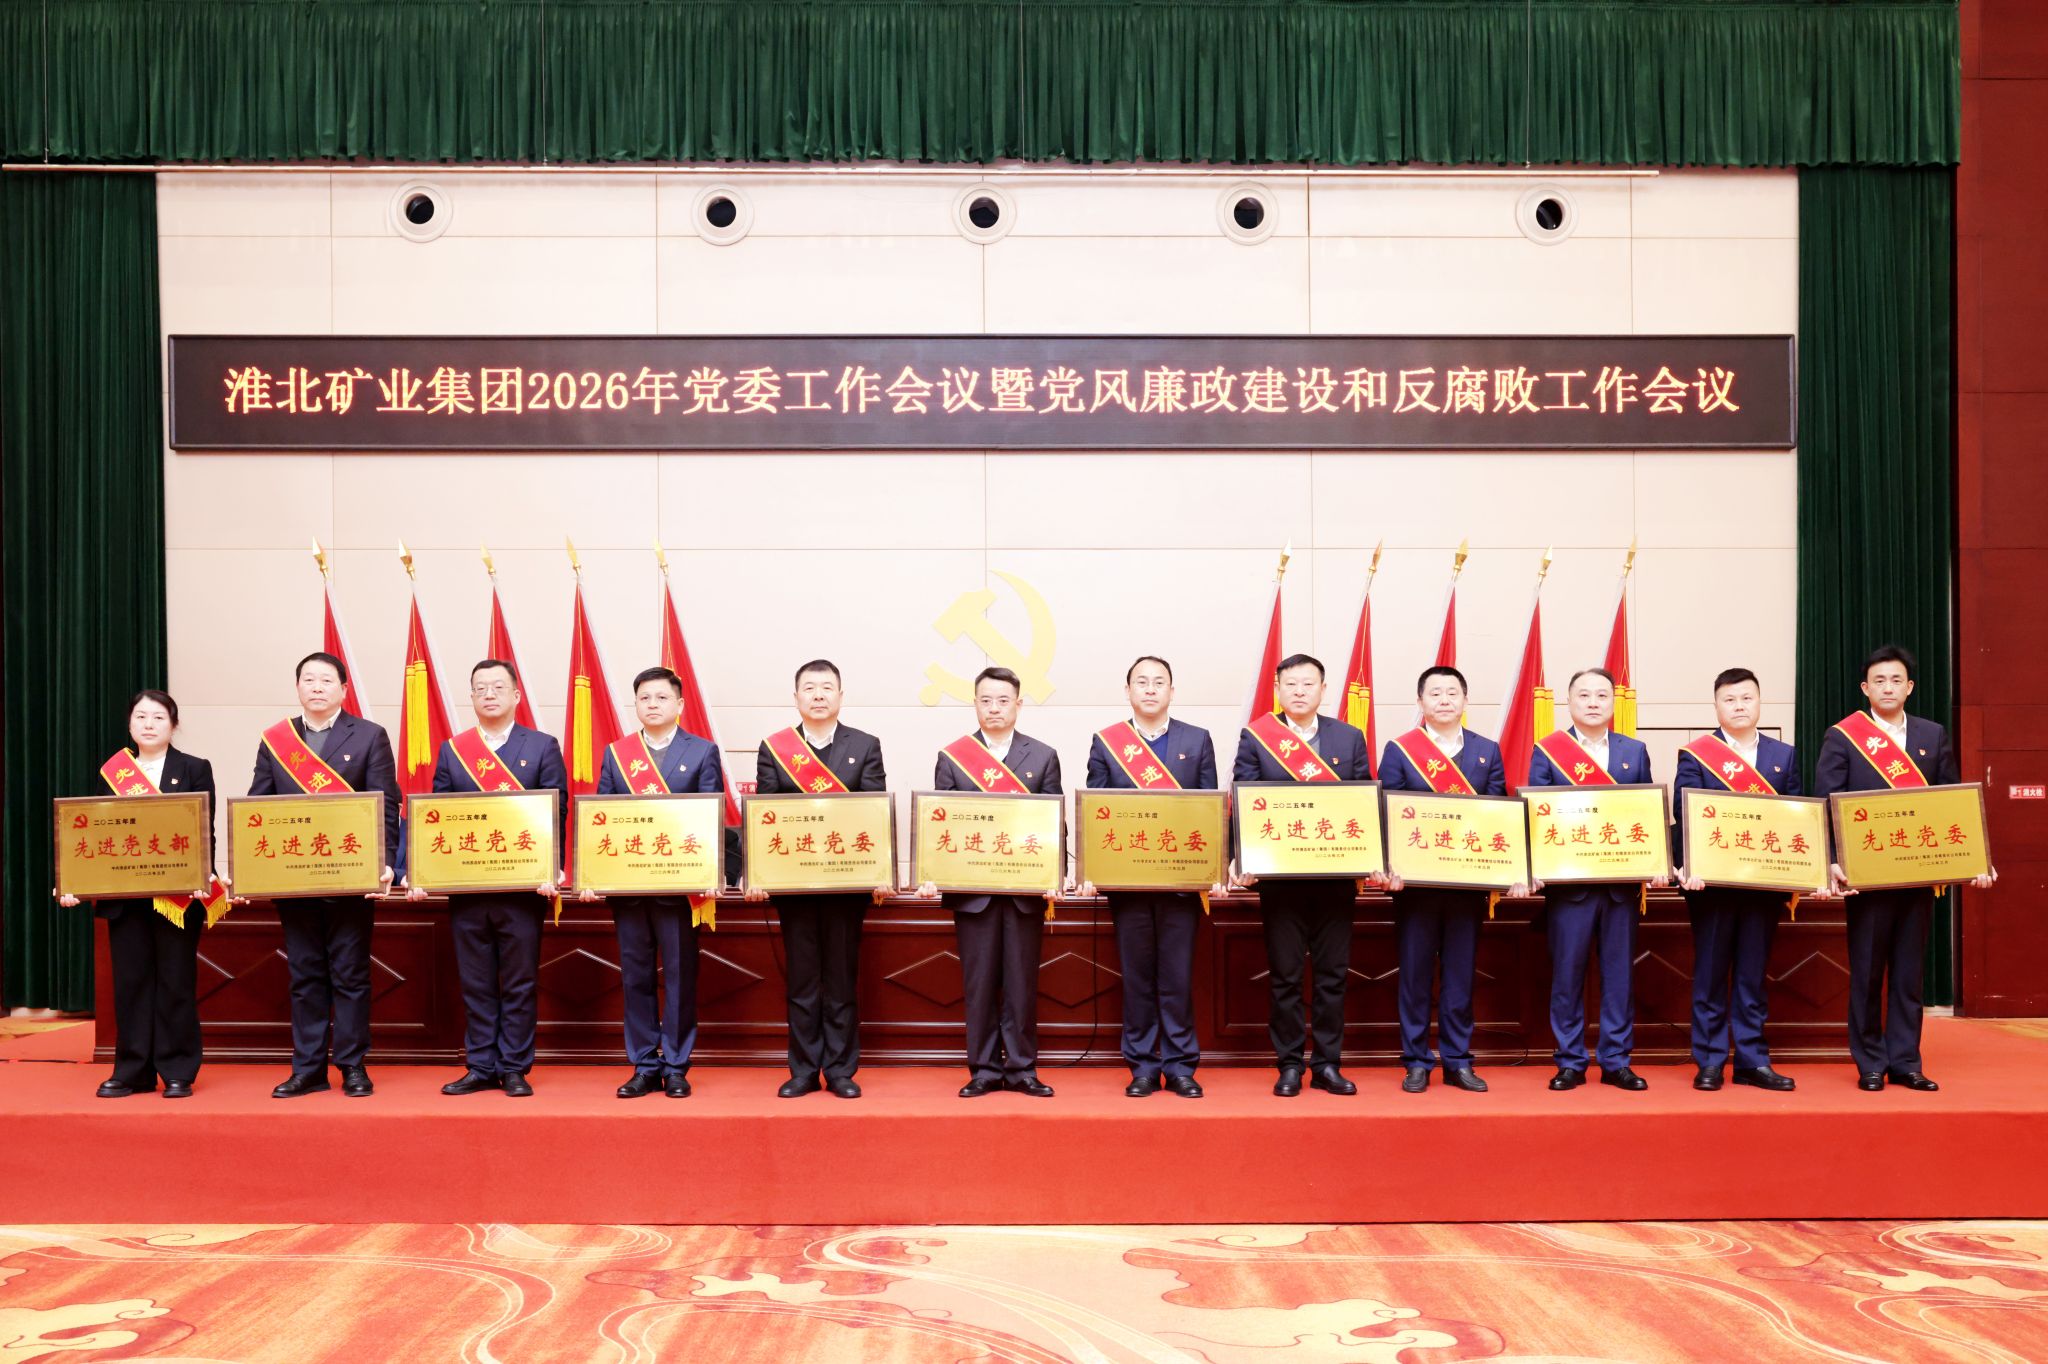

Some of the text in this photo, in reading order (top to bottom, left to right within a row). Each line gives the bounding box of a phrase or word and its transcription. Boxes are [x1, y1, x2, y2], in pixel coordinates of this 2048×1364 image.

[223, 366, 1740, 415] 淮北矿业集团2026年党委工作会议暨党风廉政建设和反腐败工作会议
[1124, 744, 1163, 786] 先进
[1279, 739, 1322, 781] 先进
[1866, 736, 1909, 780] 先进
[289, 751, 332, 793] 先进
[431, 829, 537, 855] 先进党委
[936, 829, 1043, 856] 先进党委
[1102, 828, 1207, 853] 先进党委
[1260, 818, 1365, 841] 先进党委
[1407, 827, 1511, 852] 先进党委
[1544, 822, 1649, 846] 先进党委
[1708, 826, 1810, 854] 先进党委
[1862, 823, 1967, 851] 先进党委
[74, 833, 190, 859] 先进党支部
[254, 832, 362, 859] 先进党委
[597, 832, 702, 857] 先进党委
[768, 831, 875, 856] 先进党委
